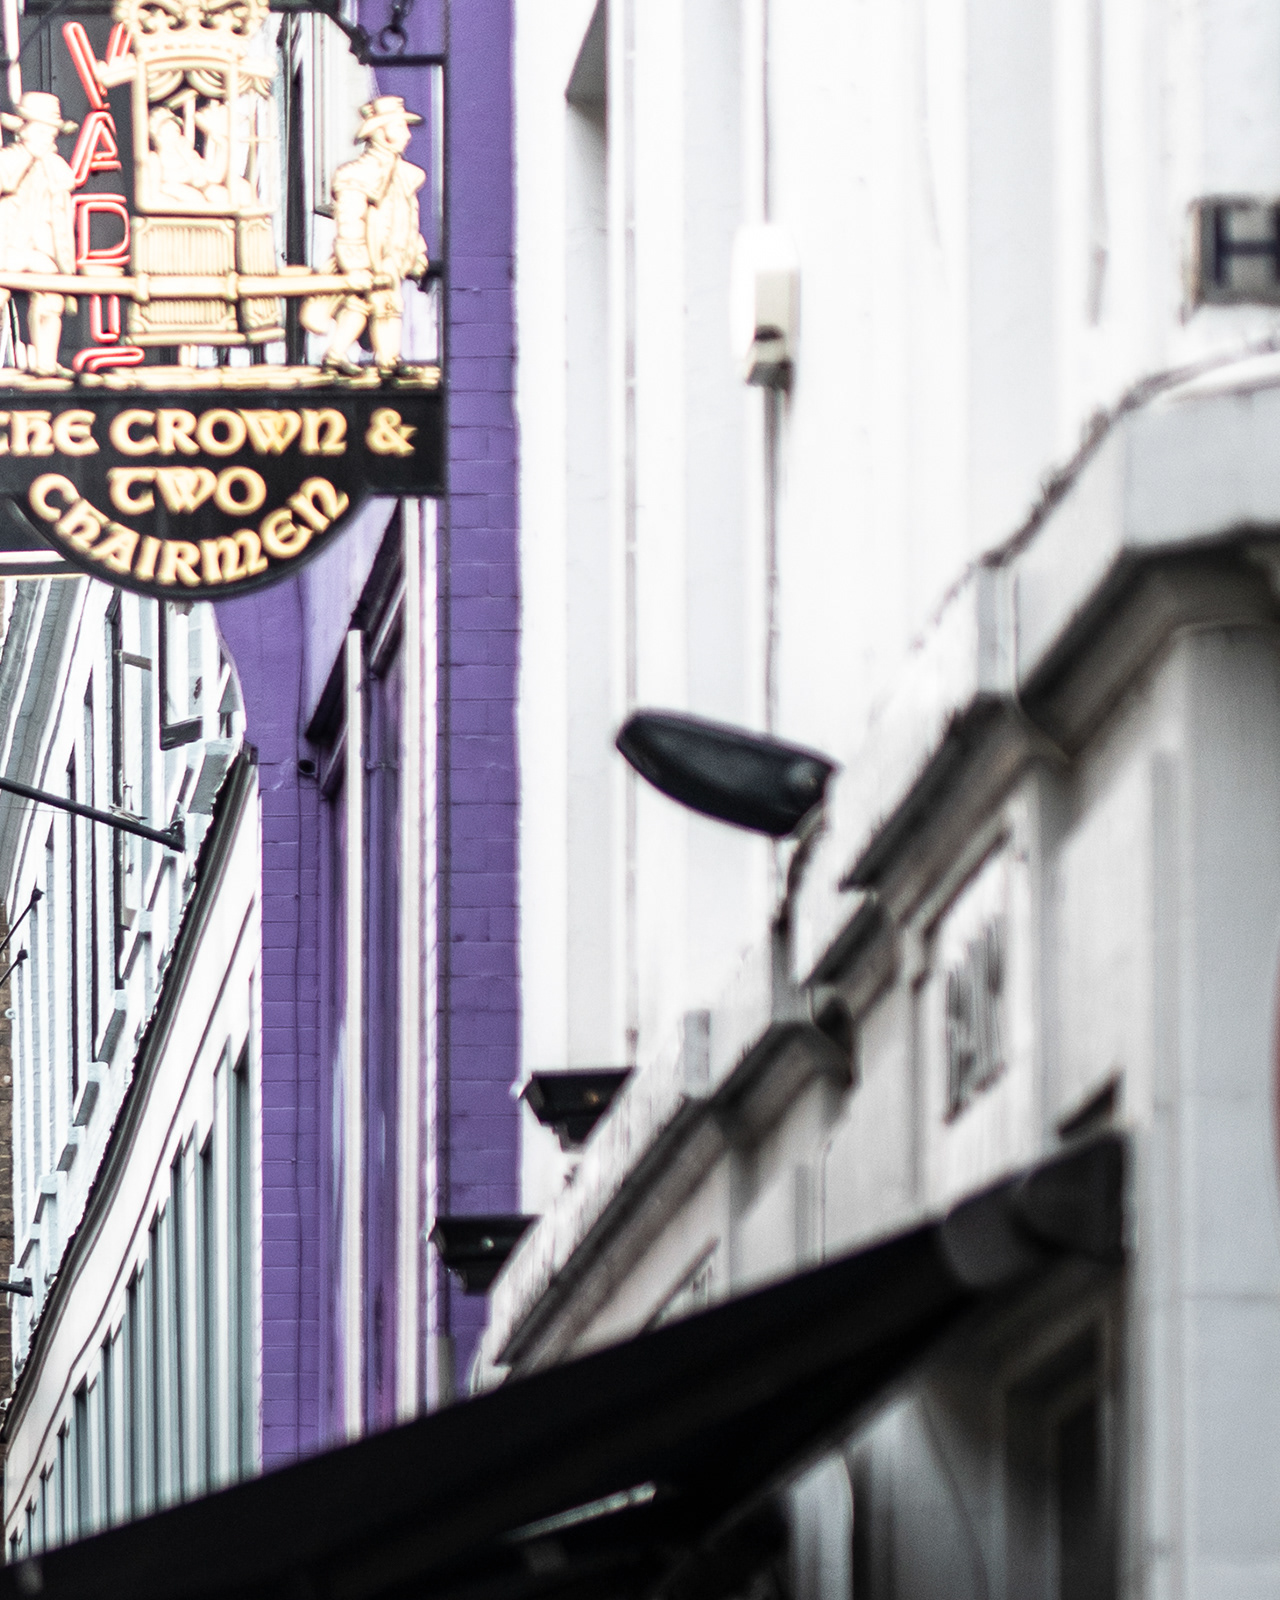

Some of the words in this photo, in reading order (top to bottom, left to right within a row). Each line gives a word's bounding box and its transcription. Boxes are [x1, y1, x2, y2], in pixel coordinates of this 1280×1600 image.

[62, 21, 145, 371] VADI
[110, 407, 348, 456] CROWN
[366, 407, 417, 455] &
[28, 472, 350, 587] CHAIRMEN
[108, 465, 267, 516] TWO
